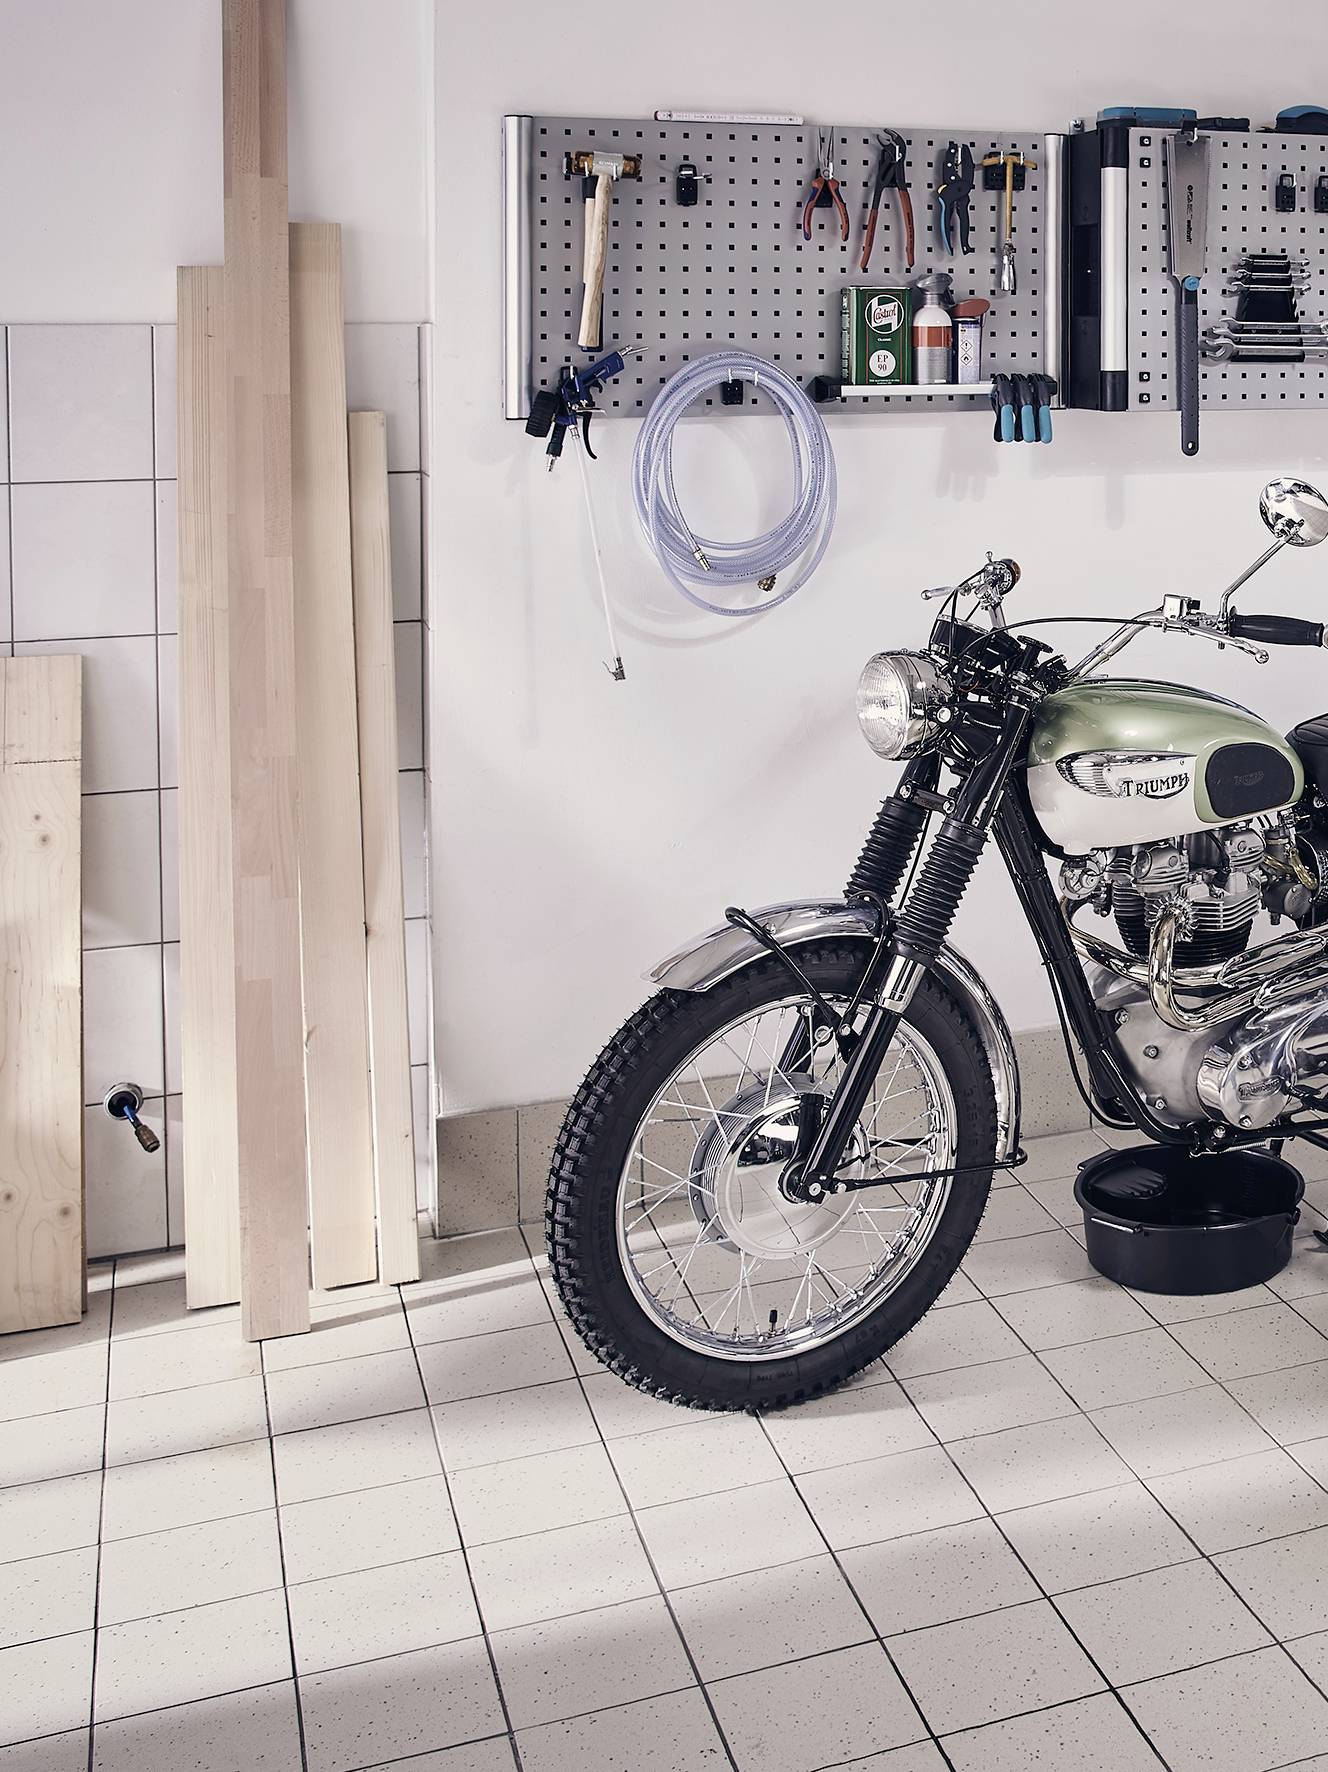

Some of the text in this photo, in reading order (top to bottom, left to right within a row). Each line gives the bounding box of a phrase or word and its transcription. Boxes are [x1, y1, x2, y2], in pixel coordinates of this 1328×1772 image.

[873, 304, 897, 324] Castrol
[877, 354, 889, 363] EP
[877, 363, 888, 372] 90
[1123, 773, 1190, 798] TRIUMPH
